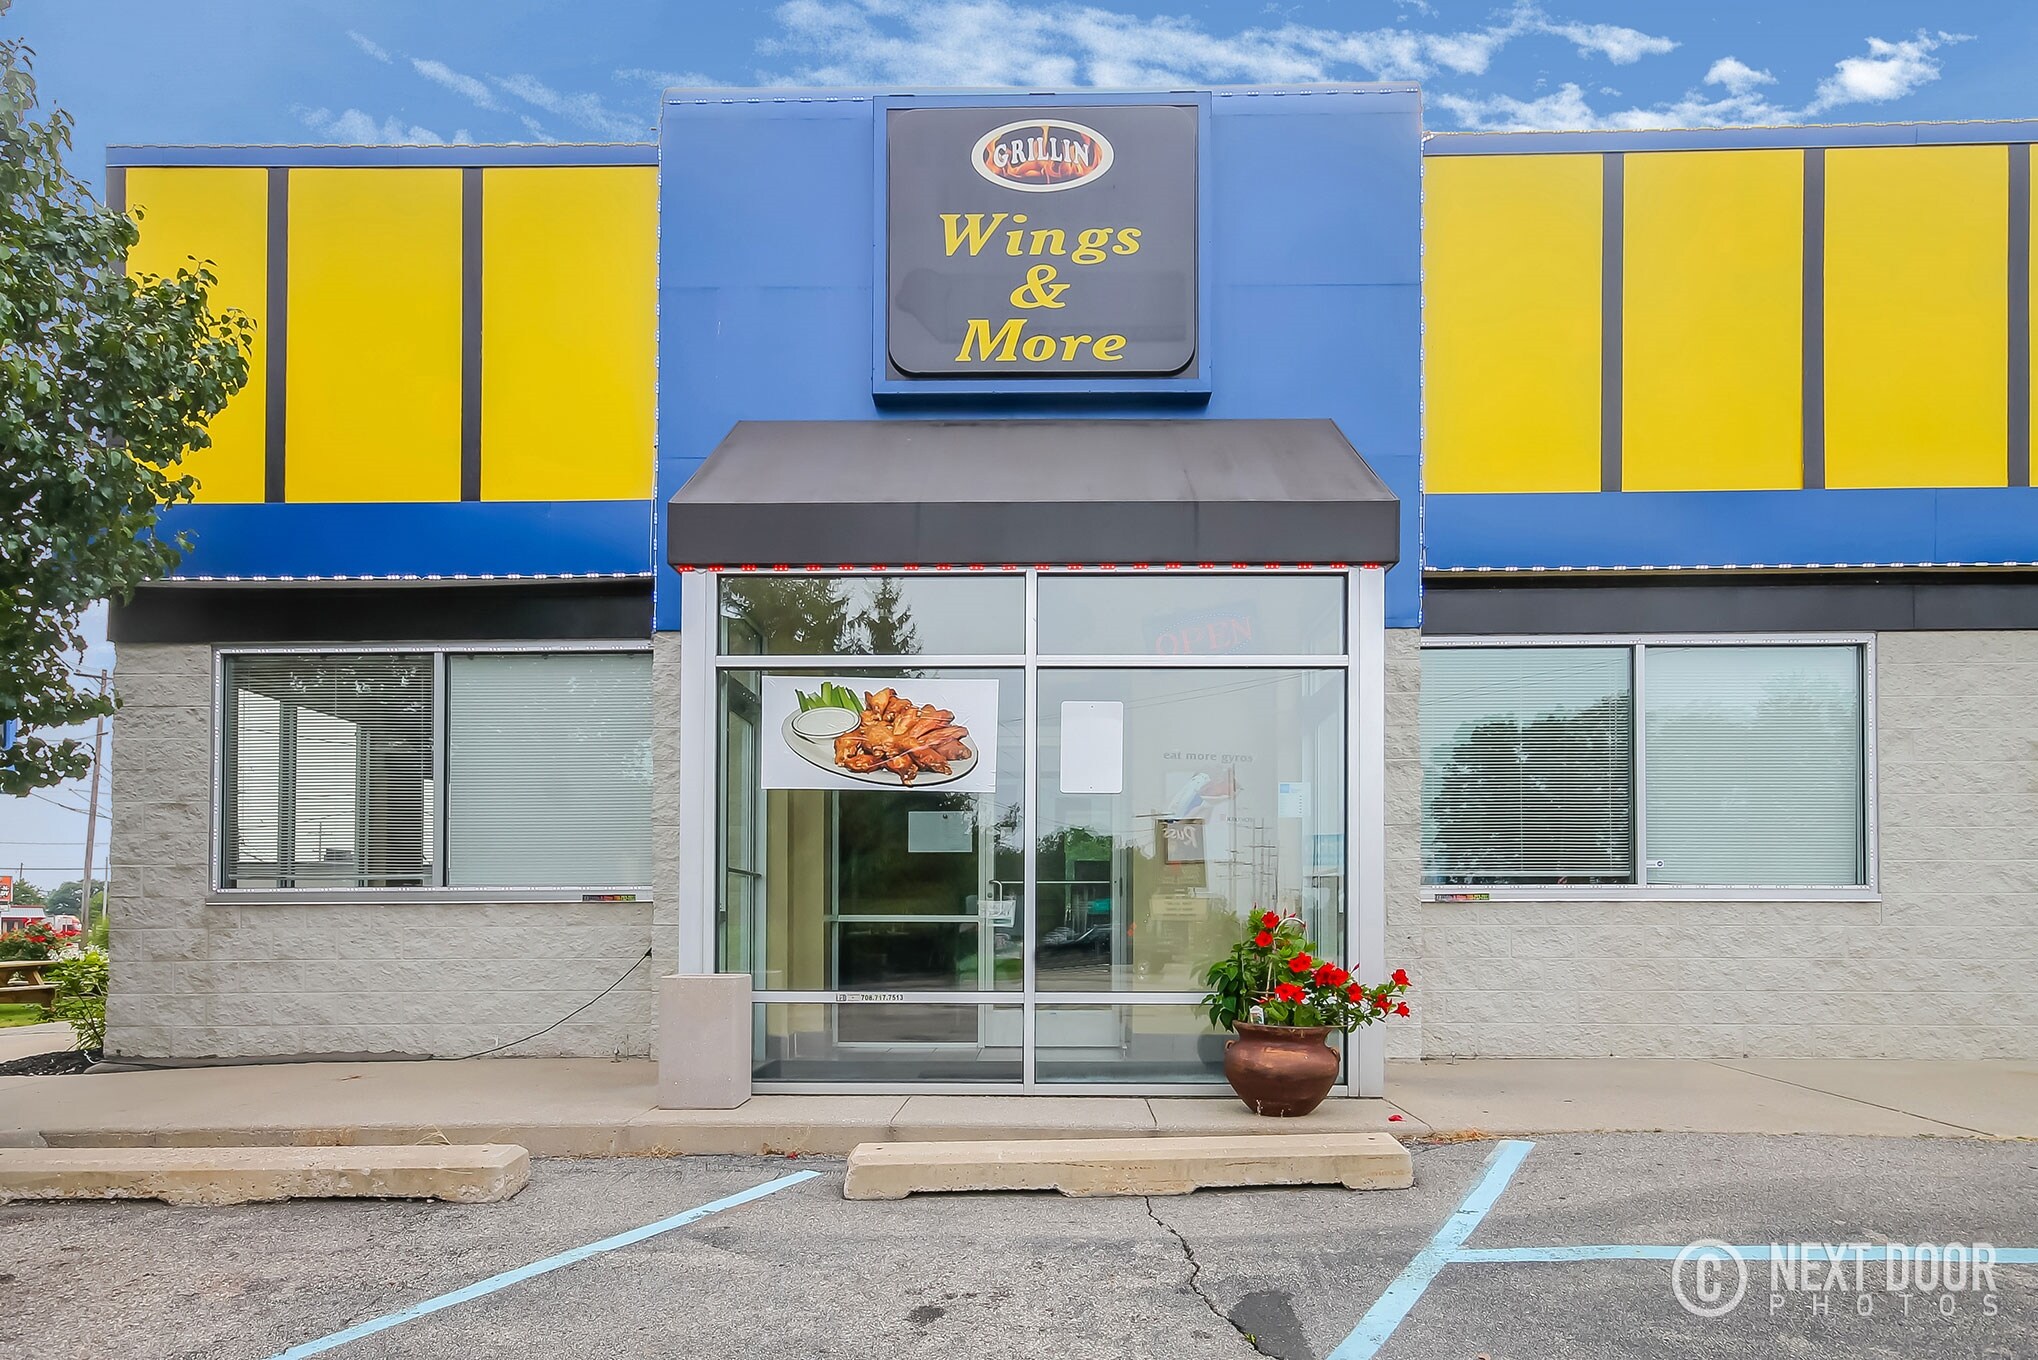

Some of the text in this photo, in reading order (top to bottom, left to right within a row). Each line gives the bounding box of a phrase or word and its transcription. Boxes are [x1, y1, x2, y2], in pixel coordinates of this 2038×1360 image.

[993, 137, 1090, 168] GRILLIN
[939, 212, 1143, 264] Wings
[1009, 264, 1071, 309] &
[955, 318, 1127, 362] More
[1155, 617, 1252, 655] OPEN
[1163, 751, 1253, 764] eat more gyros
